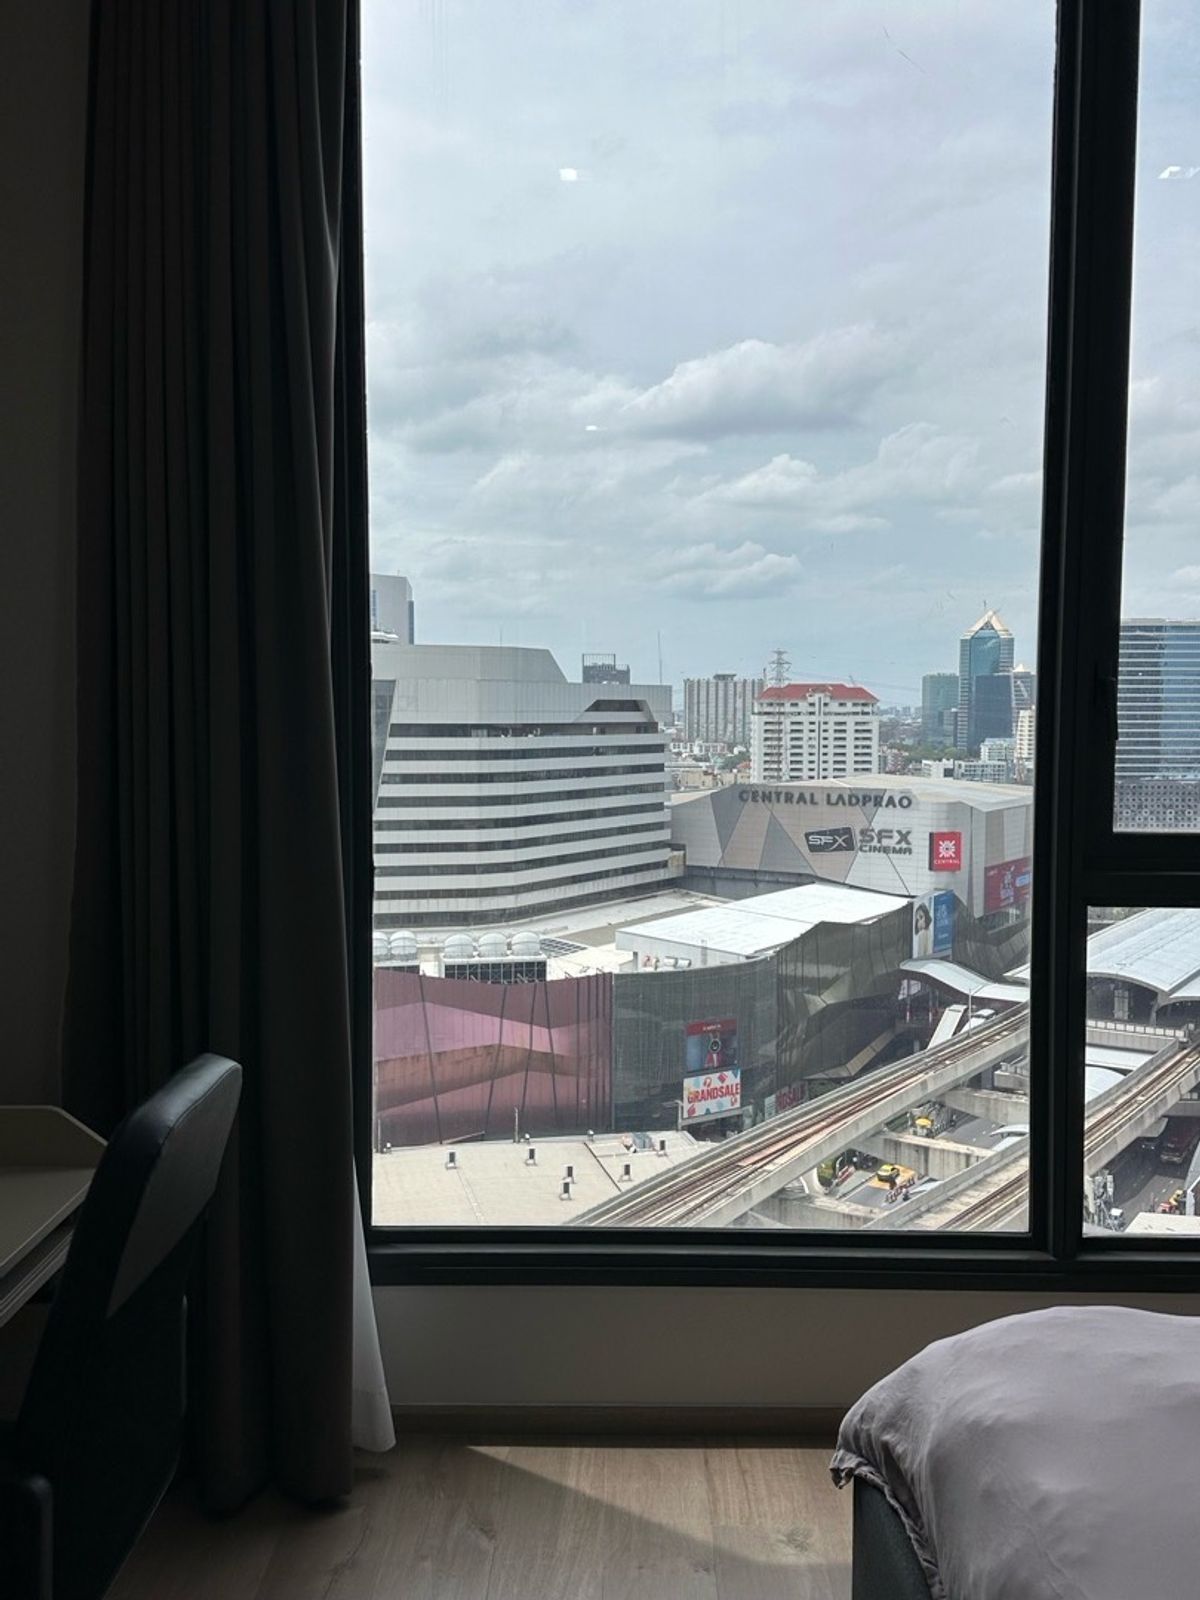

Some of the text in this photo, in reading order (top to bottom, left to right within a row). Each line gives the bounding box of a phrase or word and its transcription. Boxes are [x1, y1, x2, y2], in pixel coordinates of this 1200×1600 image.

[738, 790, 913, 809] CENTRAL LADPRAO
[808, 834, 850, 851] SFX
[859, 828, 913, 845] SFX
[859, 844, 913, 855] CINEMA
